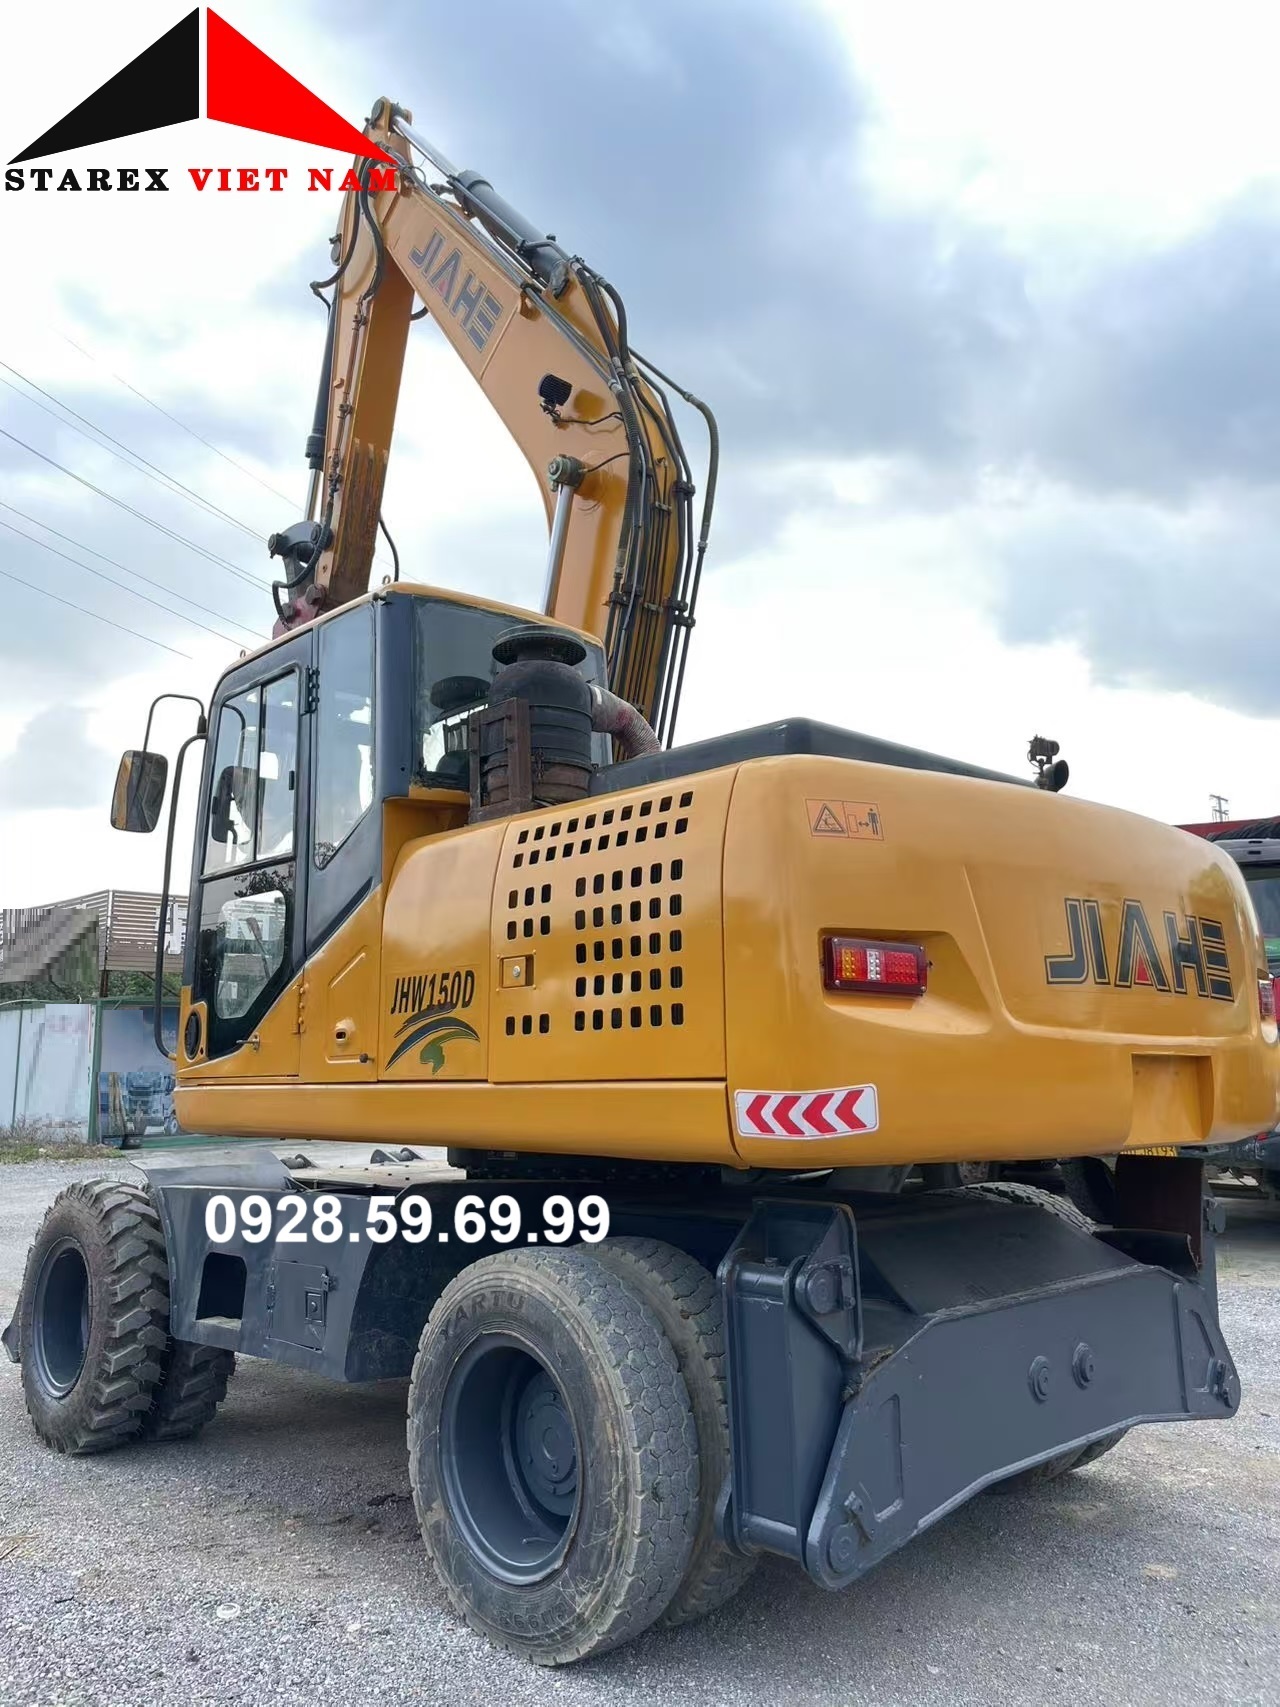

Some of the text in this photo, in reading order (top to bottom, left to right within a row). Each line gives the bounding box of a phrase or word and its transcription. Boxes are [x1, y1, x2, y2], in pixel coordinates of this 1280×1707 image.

[408, 227, 504, 353] JIAHE
[390, 969, 476, 1014] JHW150D
[1044, 897, 1235, 1003] JIAHE
